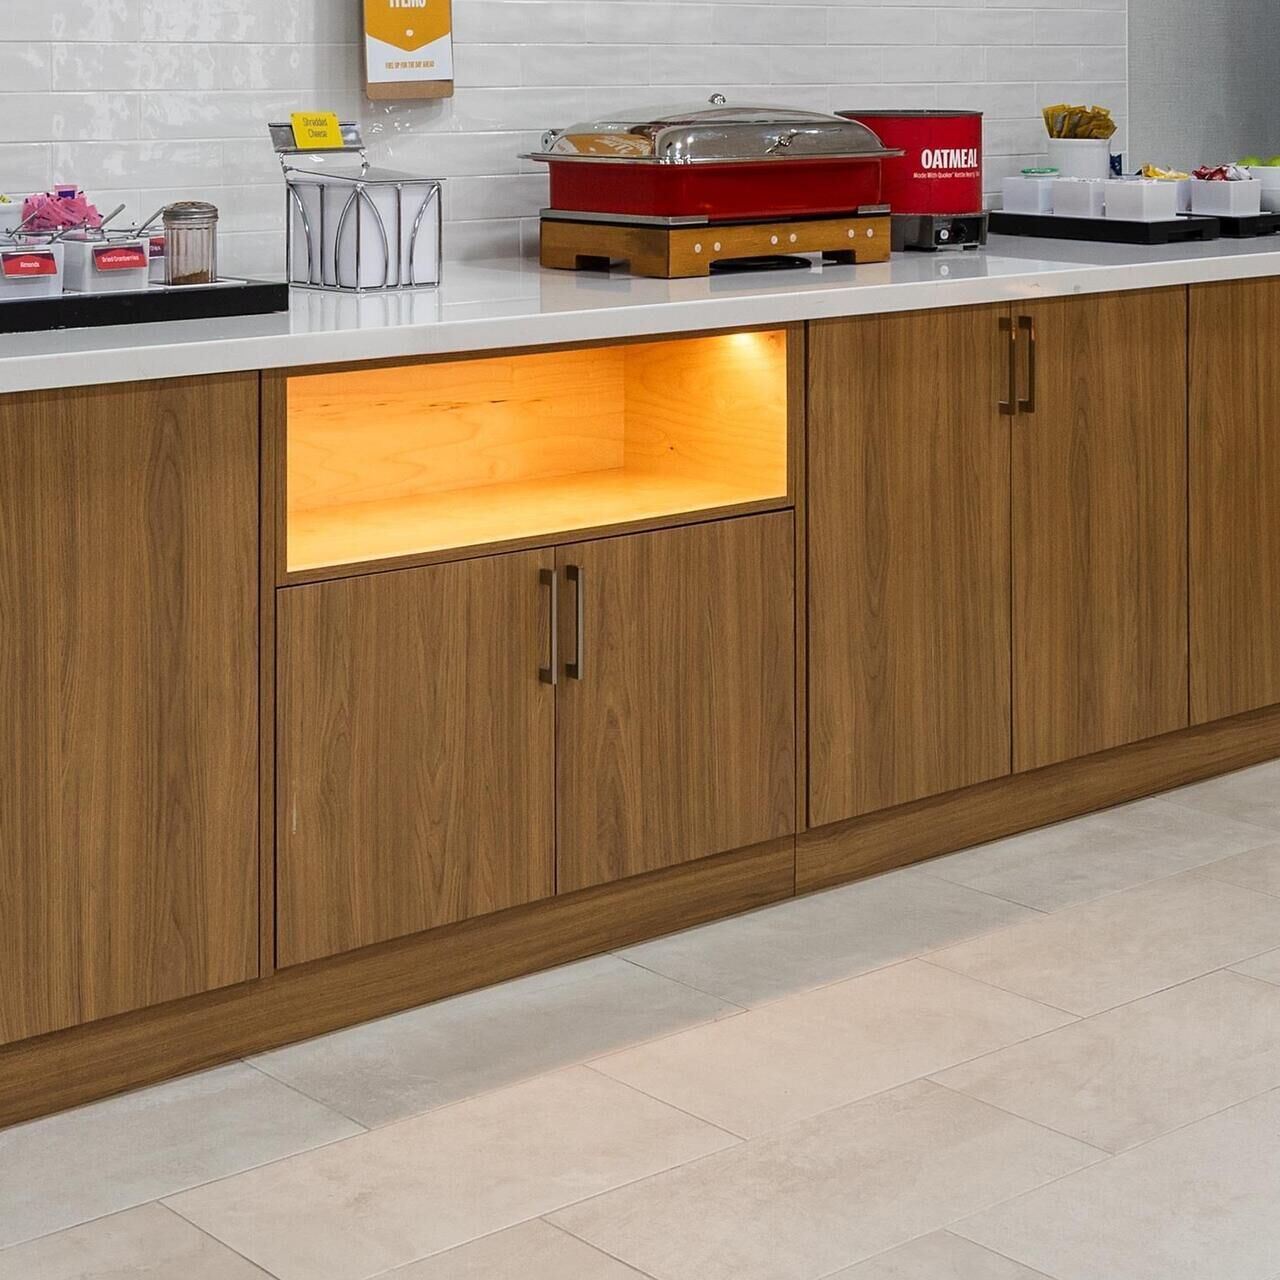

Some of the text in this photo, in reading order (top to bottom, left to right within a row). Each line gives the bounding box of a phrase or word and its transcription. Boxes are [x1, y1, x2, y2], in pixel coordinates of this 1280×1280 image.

[302, 117, 328, 127] Shredded
[308, 128, 328, 138] Cheese
[921, 148, 978, 169] OATMEAL
